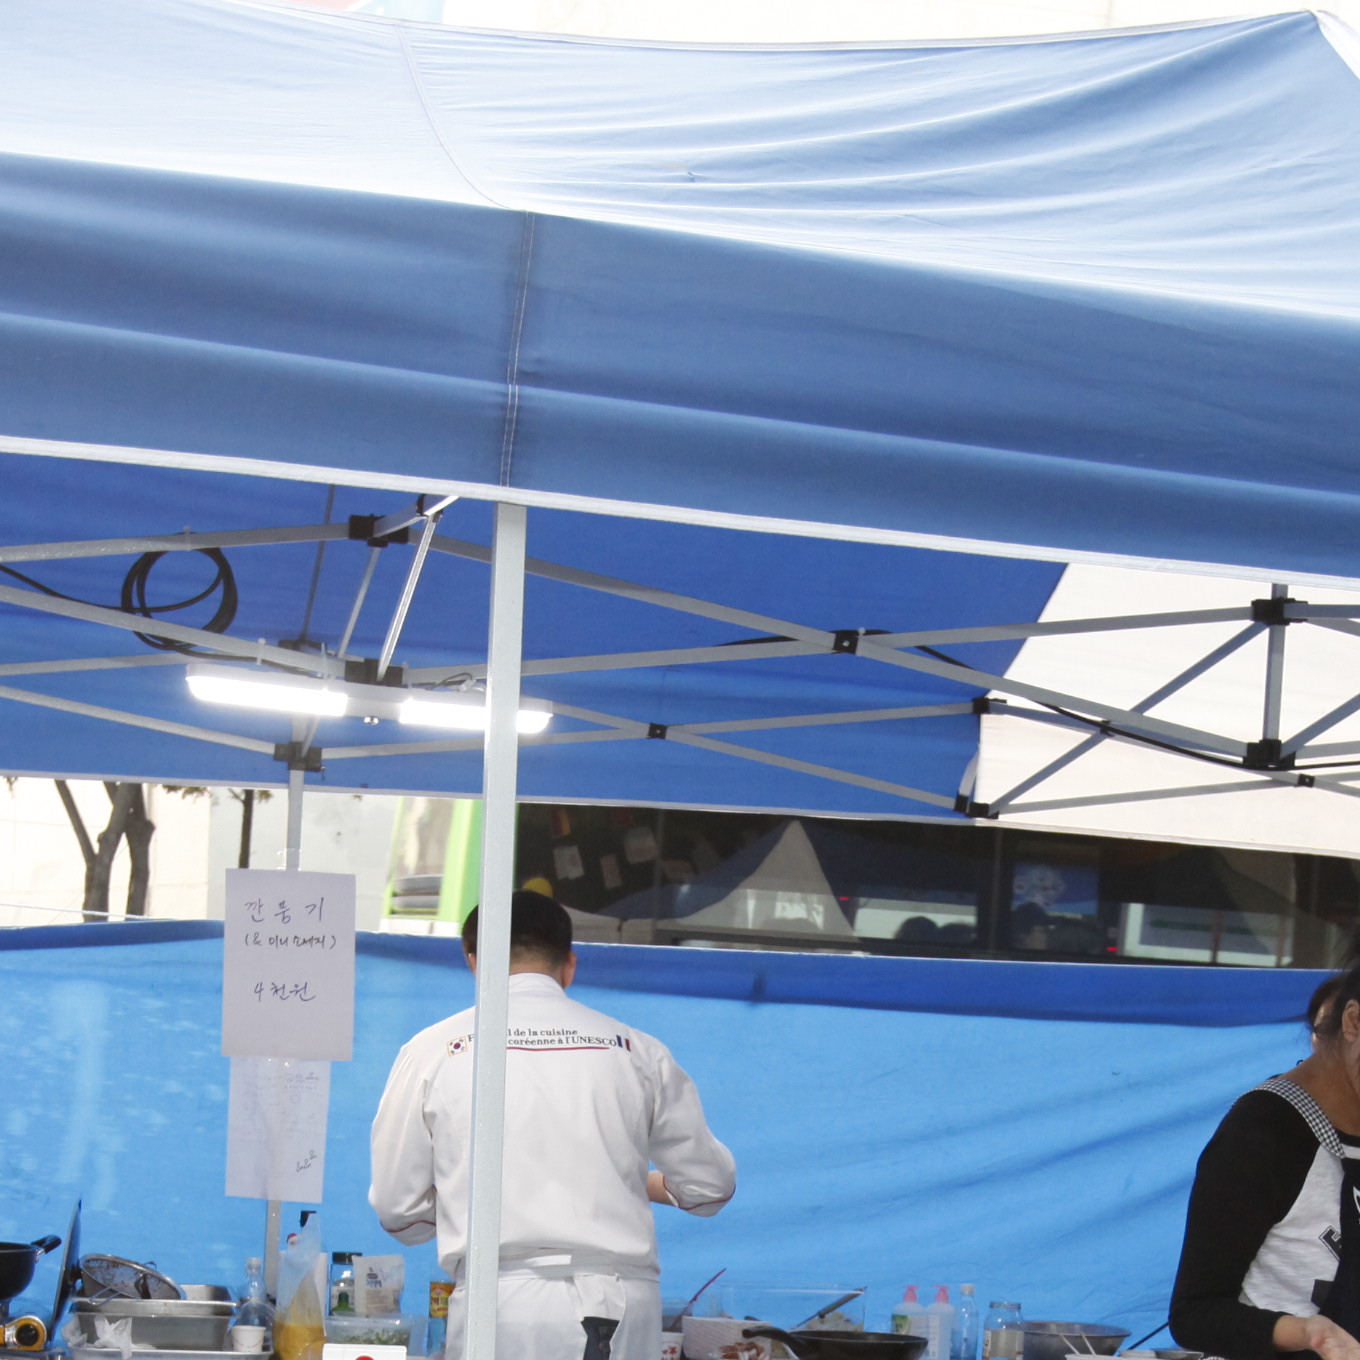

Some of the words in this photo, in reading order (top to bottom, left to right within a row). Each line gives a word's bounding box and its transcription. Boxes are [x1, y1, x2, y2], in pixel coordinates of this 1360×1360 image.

[513, 1028, 527, 1037] de
[528, 1028, 538, 1036] la
[539, 1028, 578, 1037] cuisine
[508, 1035, 557, 1046] coréenne
